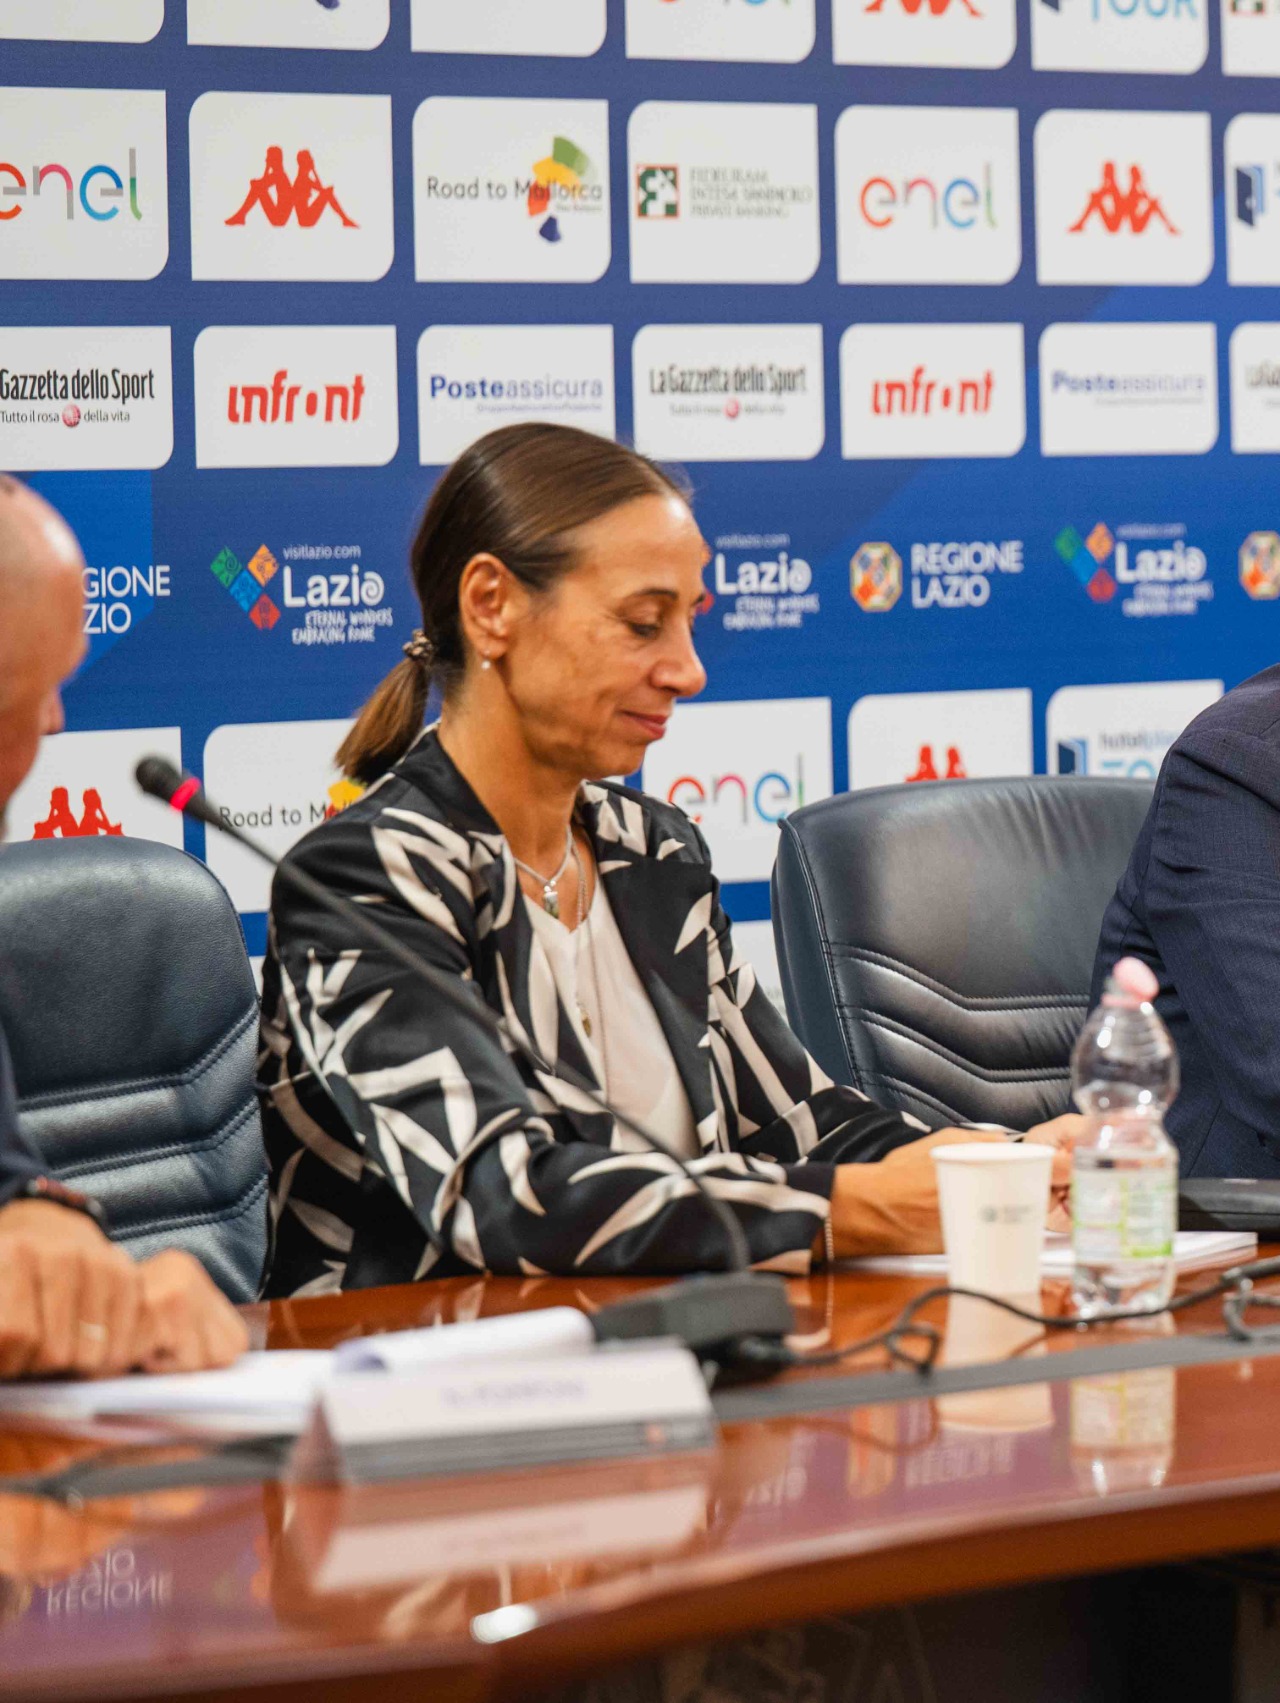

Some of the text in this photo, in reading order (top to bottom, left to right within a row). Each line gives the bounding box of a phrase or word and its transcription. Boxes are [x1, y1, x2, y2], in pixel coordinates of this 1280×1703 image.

[0, 148, 142, 221] enel
[427, 176, 603, 200] Road to Mallorca
[859, 161, 997, 228] enel
[0, 367, 155, 405] Gazzetta dello Sport
[228, 369, 365, 423] infront
[768, 365, 806, 398] Sport
[872, 366, 993, 415] infront
[0, 410, 130, 423] Tutto il rosa della vita
[283, 544, 361, 560] visitlazio.com
[911, 540, 1024, 575] REGIONE
[1115, 540, 1207, 584] Lazio
[82, 565, 171, 598] GIONE
[283, 563, 385, 608] Lazio
[715, 551, 812, 595] Lazio
[911, 574, 990, 609] LAZIO
[82, 602, 131, 634] ZIO
[668, 752, 805, 824] enel
[219, 804, 272, 828] Road
[281, 807, 301, 825] to
